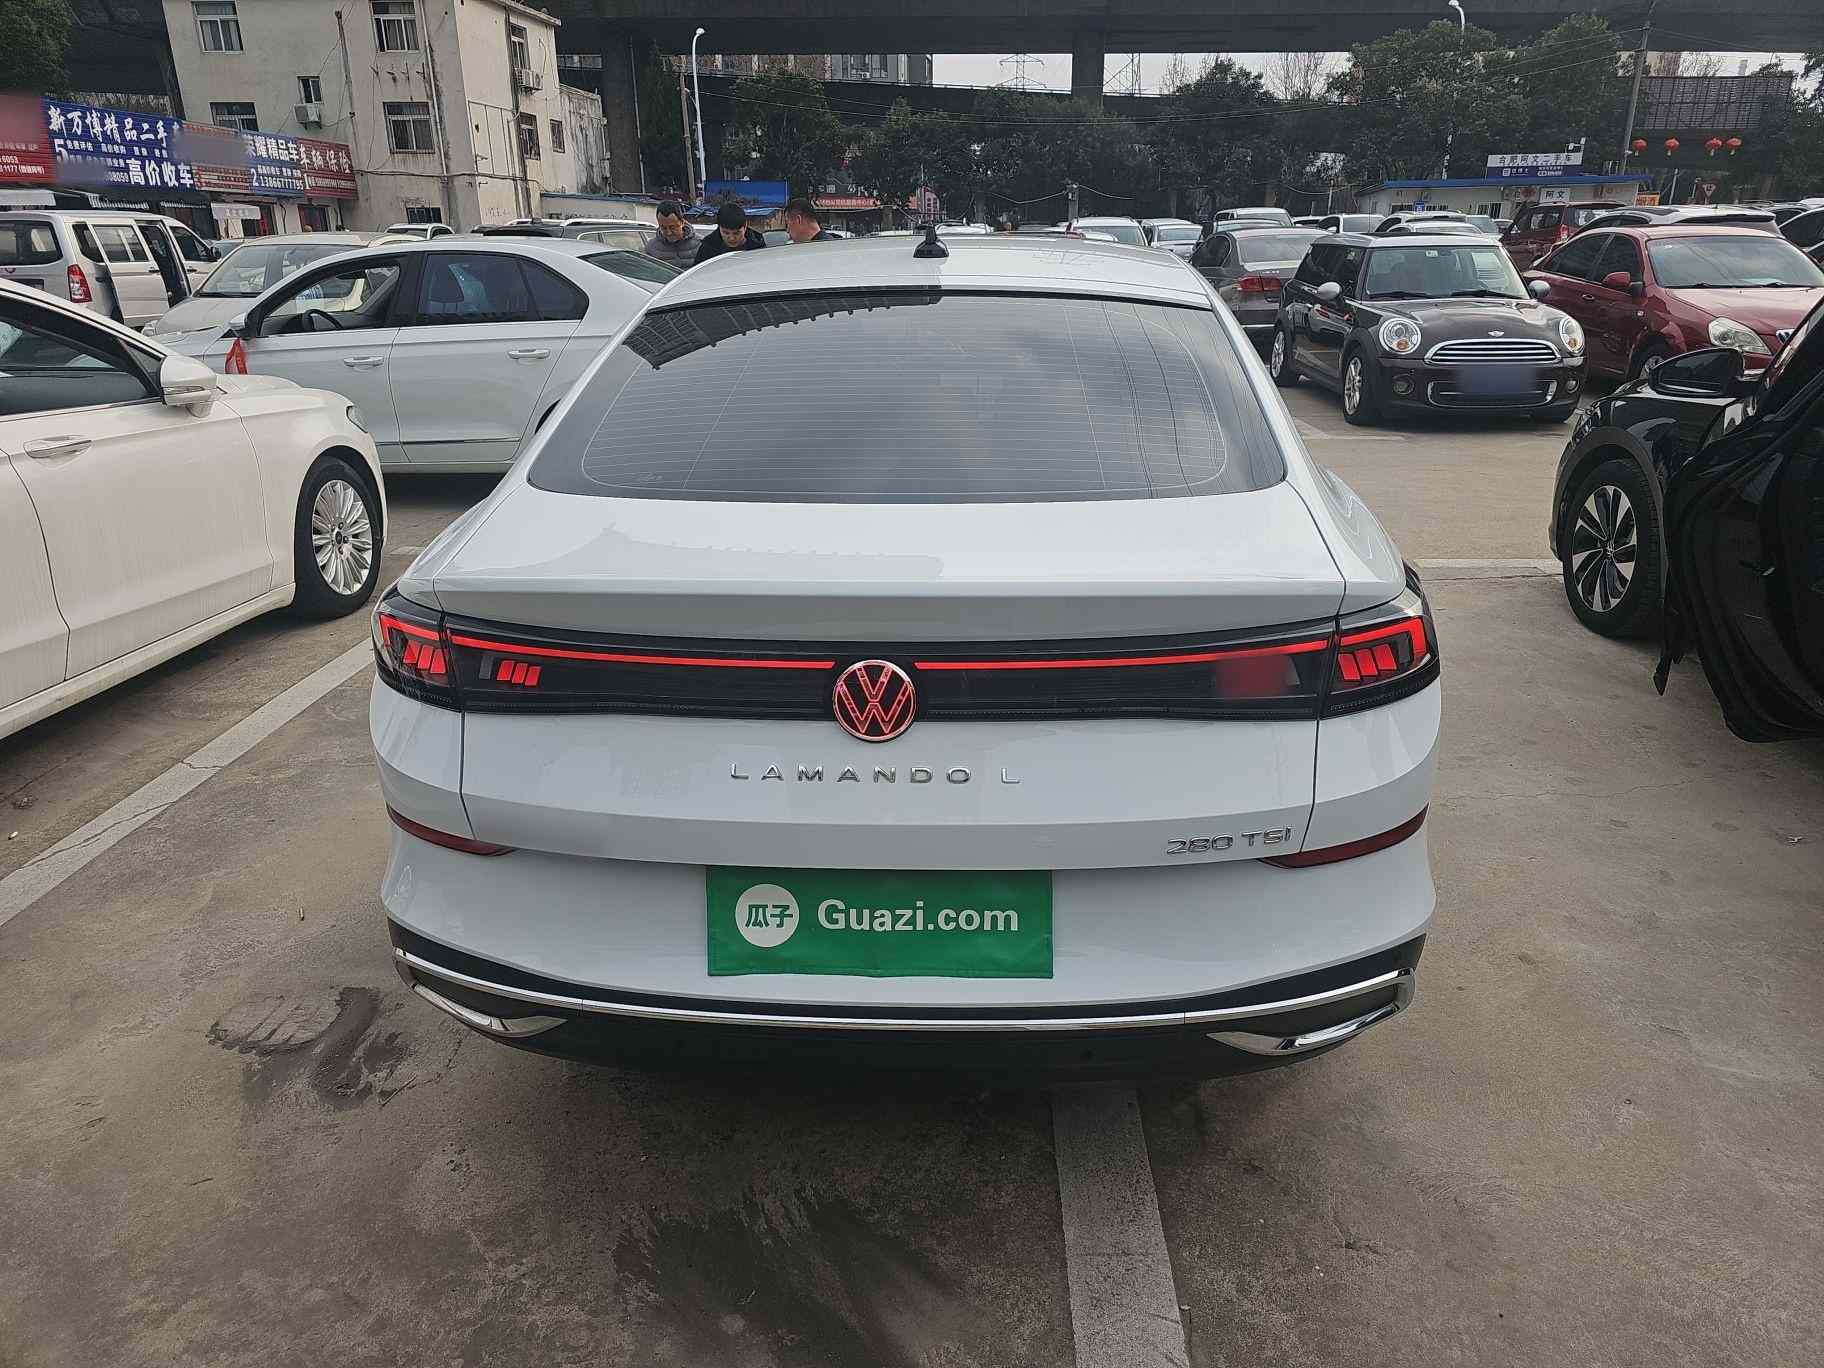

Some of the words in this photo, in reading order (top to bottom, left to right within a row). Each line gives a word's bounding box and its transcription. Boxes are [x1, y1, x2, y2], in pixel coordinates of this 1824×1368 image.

[48, 105, 179, 148] 新万博精品二手
[126, 158, 194, 188] 高价收车
[299, 144, 351, 173] 车辆保险
[250, 168, 259, 186] 2
[1545, 191, 1567, 200] 阿文
[730, 762, 972, 785] LAMANDO
[1000, 767, 1022, 785] L
[1166, 835, 1233, 856] 280
[1242, 826, 1293, 847] TSI
[745, 903, 793, 929] 瓜子
[817, 898, 1020, 933] Guazi.com
